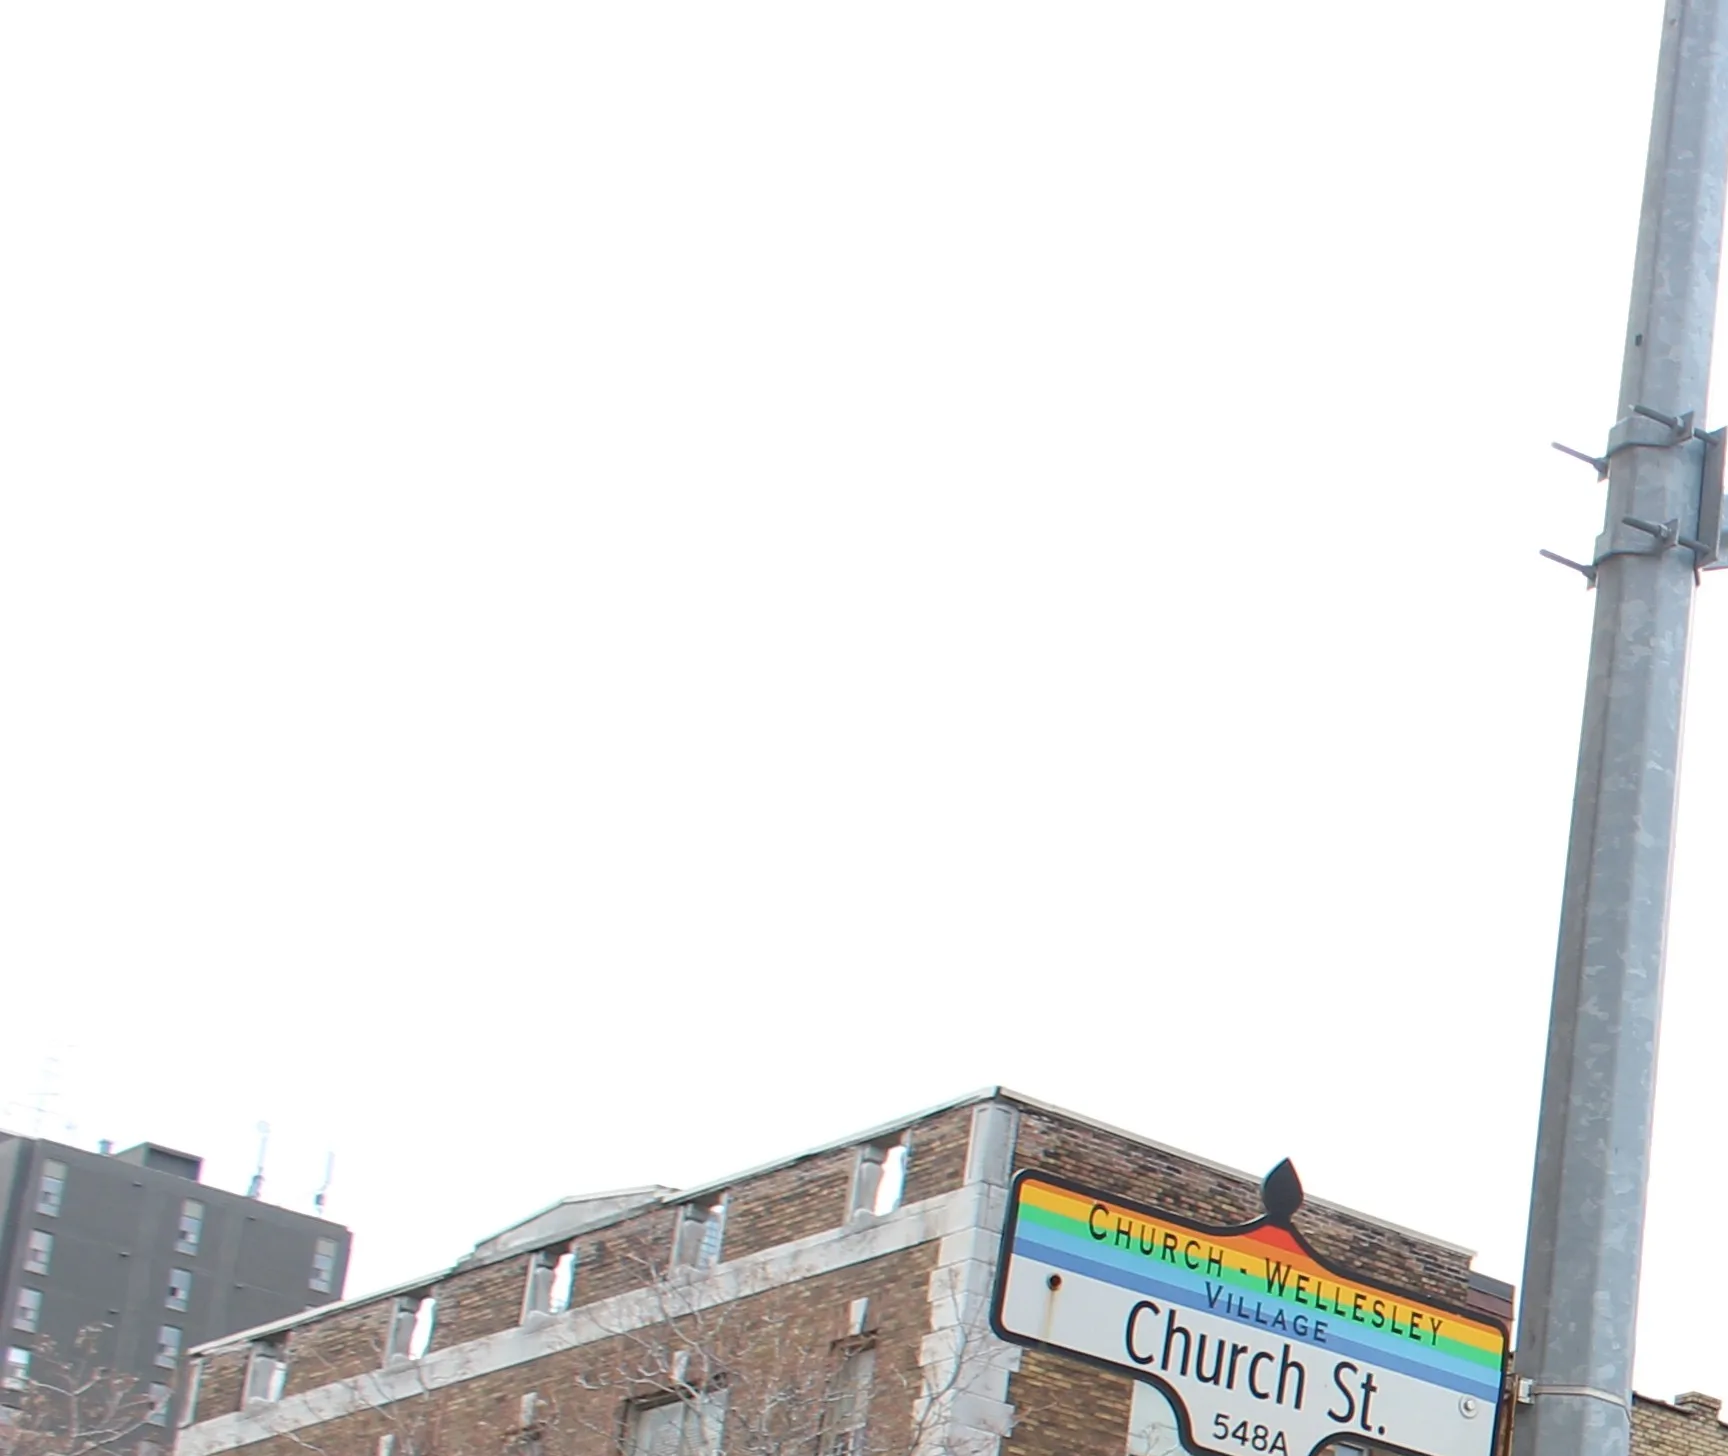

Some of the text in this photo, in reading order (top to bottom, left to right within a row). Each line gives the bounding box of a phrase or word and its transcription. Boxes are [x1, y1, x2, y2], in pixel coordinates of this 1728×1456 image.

[1088, 1203, 1224, 1278] CHURCH
[1265, 1257, 1444, 1346] WELLESLEY
[1205, 1281, 1328, 1343] VILLAGE
[1126, 1300, 1386, 1436] Church St.
